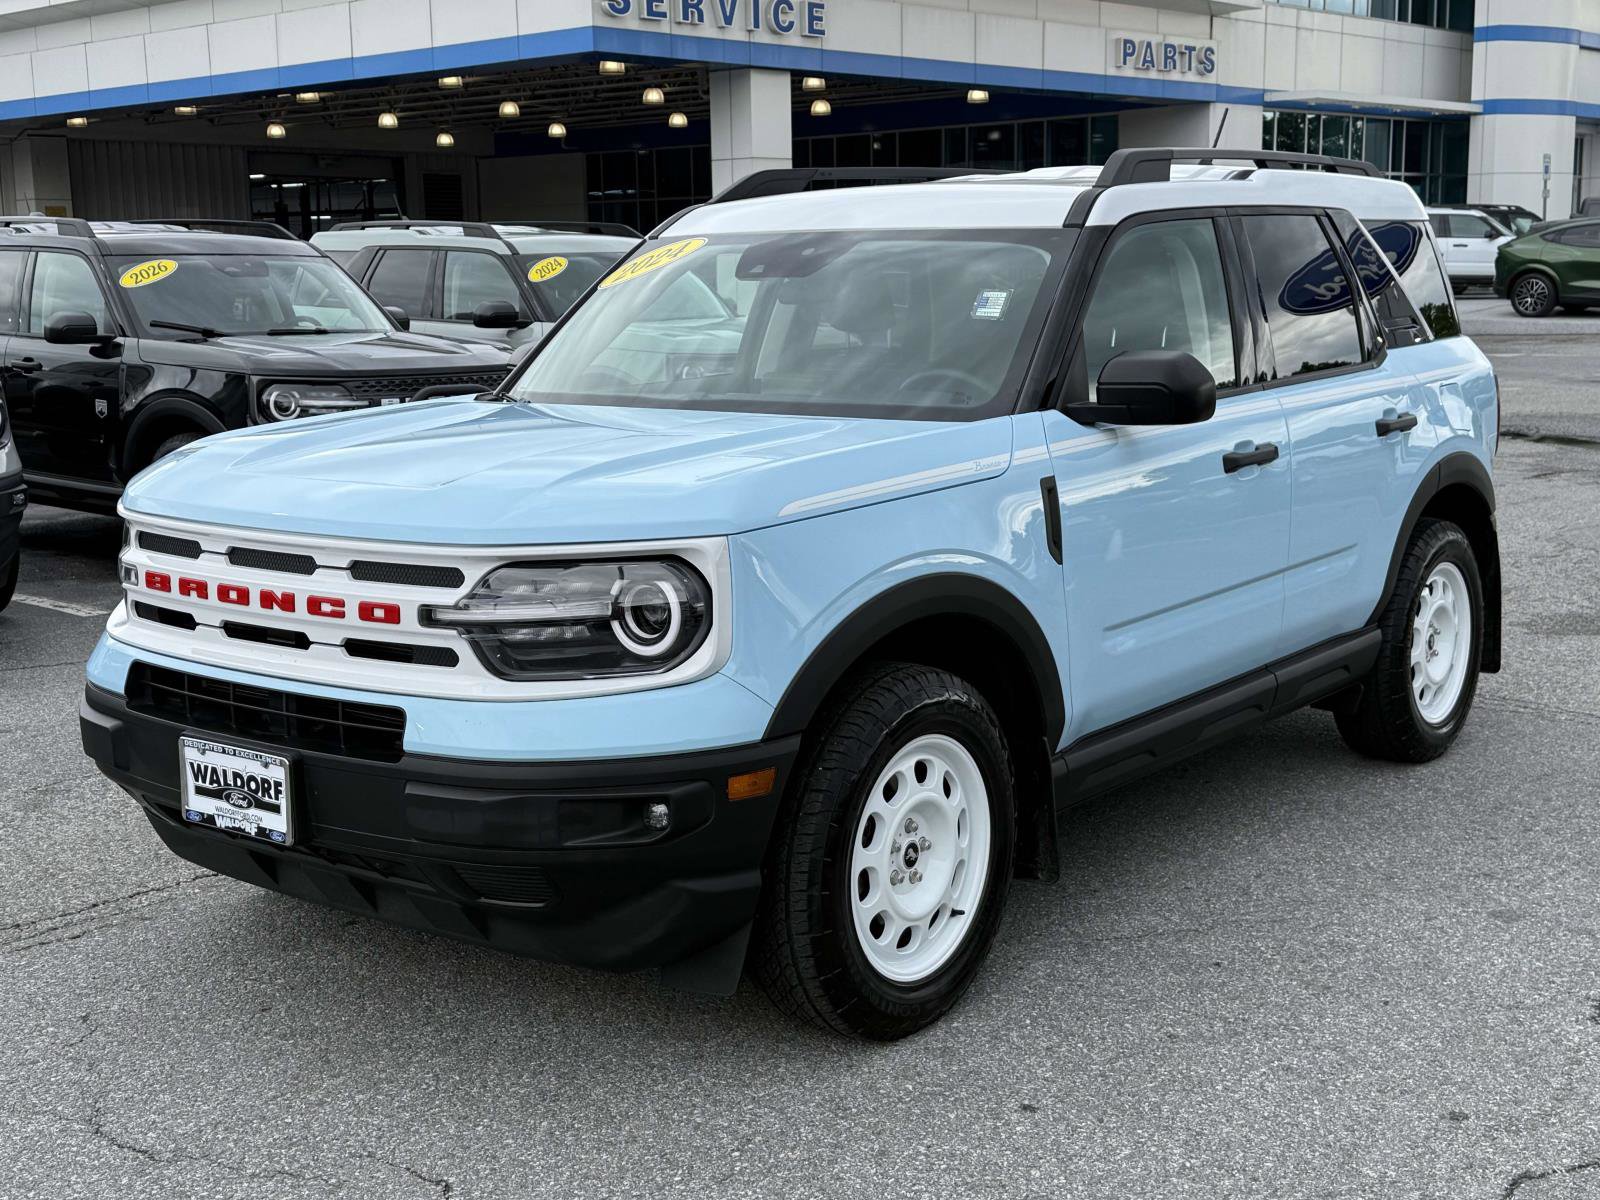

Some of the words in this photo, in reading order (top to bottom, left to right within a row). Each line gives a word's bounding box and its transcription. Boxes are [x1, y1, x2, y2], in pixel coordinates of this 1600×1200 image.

[1120, 38, 1216, 74] PARTS
[129, 261, 168, 285] 2026
[535, 257, 563, 279] 2024
[610, 240, 692, 283] 2024
[144, 569, 401, 625] BRONCO
[184, 739, 223, 753] DEDICATED
[224, 747, 234, 755] TO
[235, 750, 281, 766] EXCELLENCE
[188, 760, 283, 802] WALDORF
[229, 791, 249, 808] Ford
[213, 813, 259, 836] WALDORF
[214, 804, 264, 823] WALDORFFORD.COM
